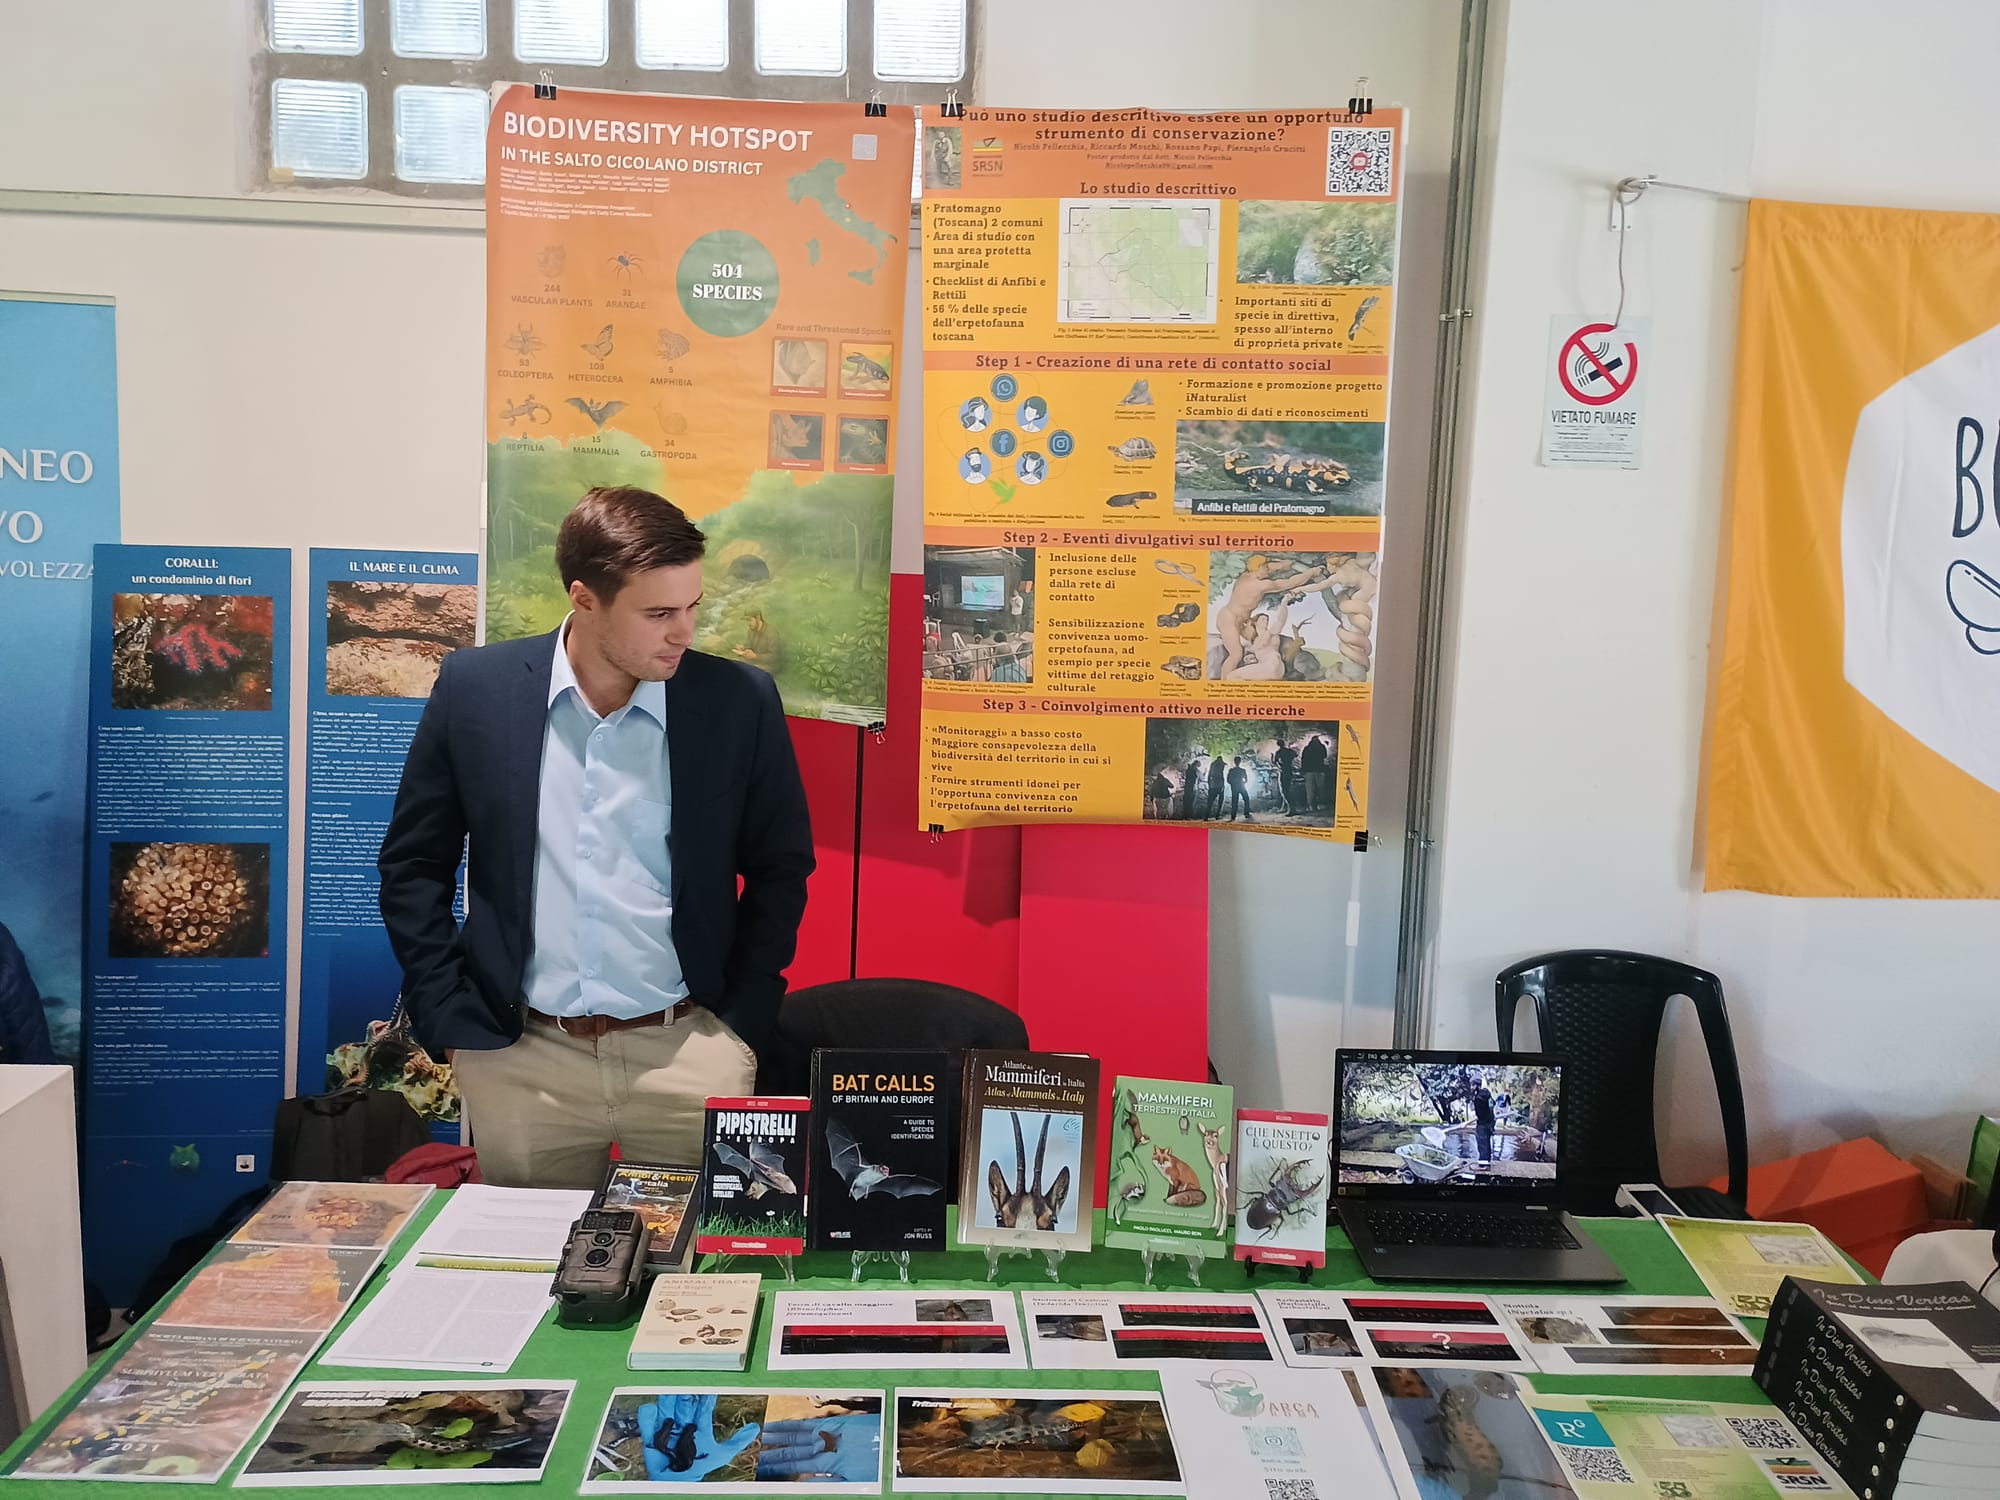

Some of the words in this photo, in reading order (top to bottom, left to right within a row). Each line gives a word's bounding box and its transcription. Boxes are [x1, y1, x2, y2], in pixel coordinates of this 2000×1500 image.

[995, 112, 1026, 123] uno
[1033, 110, 1085, 123] studio
[1091, 108, 1181, 124] descrittivo
[1246, 114, 1267, 124] un
[1274, 111, 1363, 126] opportuno
[503, 111, 682, 146] BIODIVERSITY
[690, 125, 813, 152] HOTSPOT
[1035, 127, 1124, 140] strumento
[1130, 126, 1146, 139] di
[1152, 128, 1285, 141] conservazione?
[501, 146, 517, 161] IN
[519, 149, 551, 165] THE
[554, 152, 602, 168] SALTO
[606, 155, 688, 172] CICOLANO
[692, 159, 762, 175] DISTRICT
[972, 160, 1003, 172] SRSN
[1080, 182, 1098, 194] Lo
[1103, 182, 1150, 194] studio
[1156, 183, 1237, 195] descrittivo
[933, 203, 1002, 215] Pratomagno
[933, 217, 988, 230] (Toscana)
[1001, 217, 1043, 227] comuni
[933, 231, 959, 241] Area
[976, 231, 1012, 241] studio
[985, 246, 1031, 257] protetta
[711, 263, 744, 279] 504
[933, 260, 990, 270] marginale
[932, 276, 984, 287] Checklist
[1001, 276, 1036, 287] Anfibi
[692, 284, 762, 301] SPECIES
[932, 290, 966, 300] Rettili
[560, 298, 593, 308] PLANTS
[1235, 297, 1296, 308] Importanti
[962, 304, 989, 314] delle
[992, 304, 1028, 316] specie
[1234, 311, 1269, 322] specie
[1287, 311, 1339, 322] direttiva,
[932, 332, 974, 341] toscana
[1234, 325, 1271, 336] spesso
[1248, 339, 1299, 351] proprietà
[1303, 340, 1343, 351] private
[976, 355, 1008, 370] Step
[1036, 356, 1111, 368] Creazione
[1116, 356, 1130, 368] di
[1135, 359, 1162, 369] una
[1167, 359, 1198, 370] rete
[1202, 358, 1216, 369] di
[1222, 359, 1284, 370] contatto
[1289, 359, 1331, 371] social
[1186, 379, 1253, 389] Formazione
[1266, 381, 1331, 391] promozione
[1335, 382, 1383, 393] progetto
[1186, 393, 1247, 403] iNaturalist
[1185, 406, 1233, 416] Scambio
[1251, 407, 1273, 417] dati
[1285, 408, 1369, 418] riconoscimenti
[1552, 410, 1591, 424] VIETATO
[1593, 411, 1637, 425] FUMARE
[573, 446, 620, 456] MAMMALIA
[640, 450, 697, 460] GASTROPODA
[1197, 502, 1223, 512] Anfibi
[1232, 502, 1257, 513] Rettili
[1274, 504, 1326, 515] Pratomagno
[1003, 531, 1035, 546] Step
[1063, 533, 1109, 544] Eventi
[1115, 533, 1194, 548] divulgativi
[1199, 535, 1221, 546] sul
[1225, 536, 1294, 547] territorio
[164, 557, 219, 569] CORALLI:
[1049, 553, 1107, 563] Inclusione
[1110, 553, 1137, 563] delle
[349, 561, 360, 572] IL
[362, 561, 396, 573] MARE
[398, 563, 405, 573] E
[408, 563, 419, 574] IL
[422, 564, 459, 575] CLIMA
[1049, 567, 1093, 576] persone
[1096, 567, 1136, 576] escluse
[131, 576, 146, 584] un
[148, 574, 213, 586] condominio
[215, 574, 226, 585] di
[228, 575, 252, 586] fiori
[1049, 578, 1076, 588] dalla
[1049, 593, 1095, 602] contatto
[1048, 618, 1145, 629] Sensibilizzazione
[1048, 632, 1110, 641] convivenza
[1048, 645, 1119, 656] erpetofauna,
[1047, 658, 1093, 668] esempio
[1117, 659, 1151, 669] specie
[1047, 671, 1087, 680] vittime
[1110, 672, 1155, 683] retaggio
[1047, 683, 1096, 692] culturale
[983, 699, 1014, 712] Step
[1041, 700, 1154, 716] Coinvolgimento
[1160, 704, 1201, 715] attivo
[1206, 704, 1241, 715] nelle
[1246, 704, 1305, 716] ricerche
[1020, 729, 1051, 738] basso
[1054, 730, 1082, 739] costo
[931, 737, 979, 749] Maggiore
[982, 741, 1067, 752] consapevolezza
[1070, 743, 1097, 752] della
[931, 750, 993, 762] biodiversità
[1016, 754, 1066, 764] territorio
[931, 763, 953, 772] vive
[931, 775, 967, 785] Fornire
[970, 778, 1023, 788] strumenti
[995, 792, 1056, 801] convivenza
[1023, 804, 1073, 814] territorio
[985, 1065, 1062, 1086] Mammiferi
[1067, 1078, 1086, 1088] Italia
[832, 1074, 870, 1091] BAT
[875, 1074, 935, 1092] CALLS
[832, 1095, 844, 1103] OF
[845, 1095, 879, 1104] BRITAIN
[881, 1095, 899, 1104] AND
[900, 1095, 935, 1104] EUROPE
[984, 1086, 1006, 1097] Atlas
[1011, 1086, 1056, 1100] Mammals
[1062, 1090, 1085, 1105] Italy
[1137, 1092, 1214, 1108] MAMMIFERI
[1133, 1104, 1180, 1116] TERRESTRI
[1181, 1109, 1217, 1119] D'ITALIA
[716, 1112, 797, 1136] PIPISTRELLI
[1245, 1127, 1269, 1138] CHE
[1262, 1139, 1313, 1152] QUESTO?
[662, 1174, 695, 1182] Rettili
[1841, 1292, 1895, 1305] Dino
[1895, 1294, 1971, 1306] Veritas
[1432, 1332, 1451, 1350] ?
[1845, 1343, 1873, 1377] Veritas
[1835, 1366, 1863, 1400] Veritas
[1828, 1388, 1855, 1423] Veritas
[1822, 1411, 1849, 1447] Veritas
[104, 1443, 159, 1451] 2021
[1815, 1432, 1842, 1468] Veritas
[1776, 1475, 1827, 1485] SRSN
